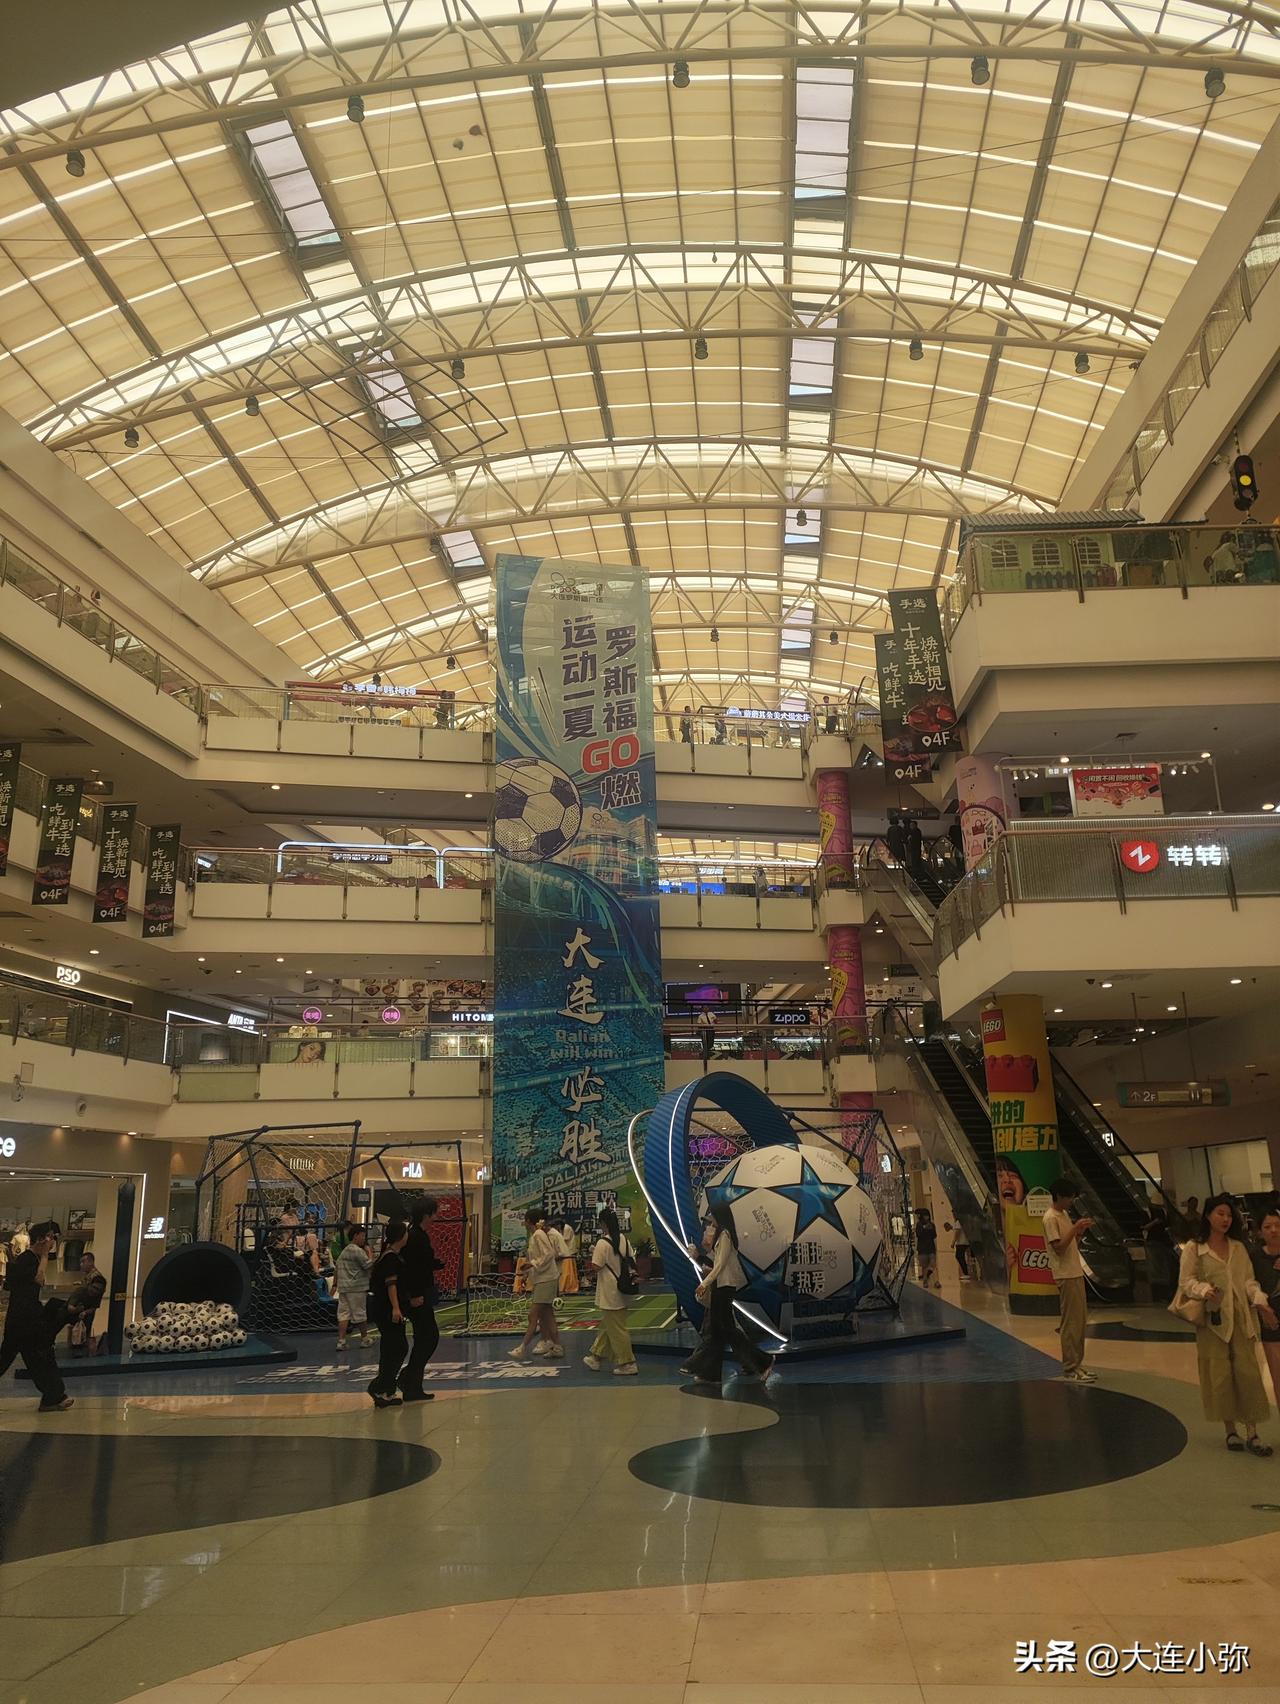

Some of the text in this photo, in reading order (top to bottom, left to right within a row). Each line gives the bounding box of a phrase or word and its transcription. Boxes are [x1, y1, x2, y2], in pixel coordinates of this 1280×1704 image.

[900, 622, 927, 685] 十年手选
[920, 635, 946, 692] 焕新相见
[559, 614, 598, 742] 运动一夏
[882, 661, 904, 708] 吃鲜牛
[581, 624, 642, 811] 罗斯福 GO 燃
[933, 731, 950, 745] 4F
[905, 764, 922, 777] 4F
[46, 802, 66, 840] 吃鲜牛
[54, 818, 74, 857] 到手选
[101, 827, 120, 874] 十年手选
[113, 837, 130, 878] 焕新相见
[150, 848, 166, 882] 吃鲜牛
[1166, 844, 1222, 867] 转转
[48, 888, 62, 899] 4F
[160, 861, 175, 894] 到手选
[107, 908, 121, 918] 4F
[156, 923, 169, 933] 4F
[56, 966, 80, 983] PSO
[557, 927, 606, 1025] 大连
[983, 1020, 1001, 1033] LEGO
[559, 1066, 613, 1165] 必胜
[402, 1159, 422, 1177] FILA
[544, 1190, 617, 1216] 我就喜欢
[1022, 1249, 1052, 1269] LEG
